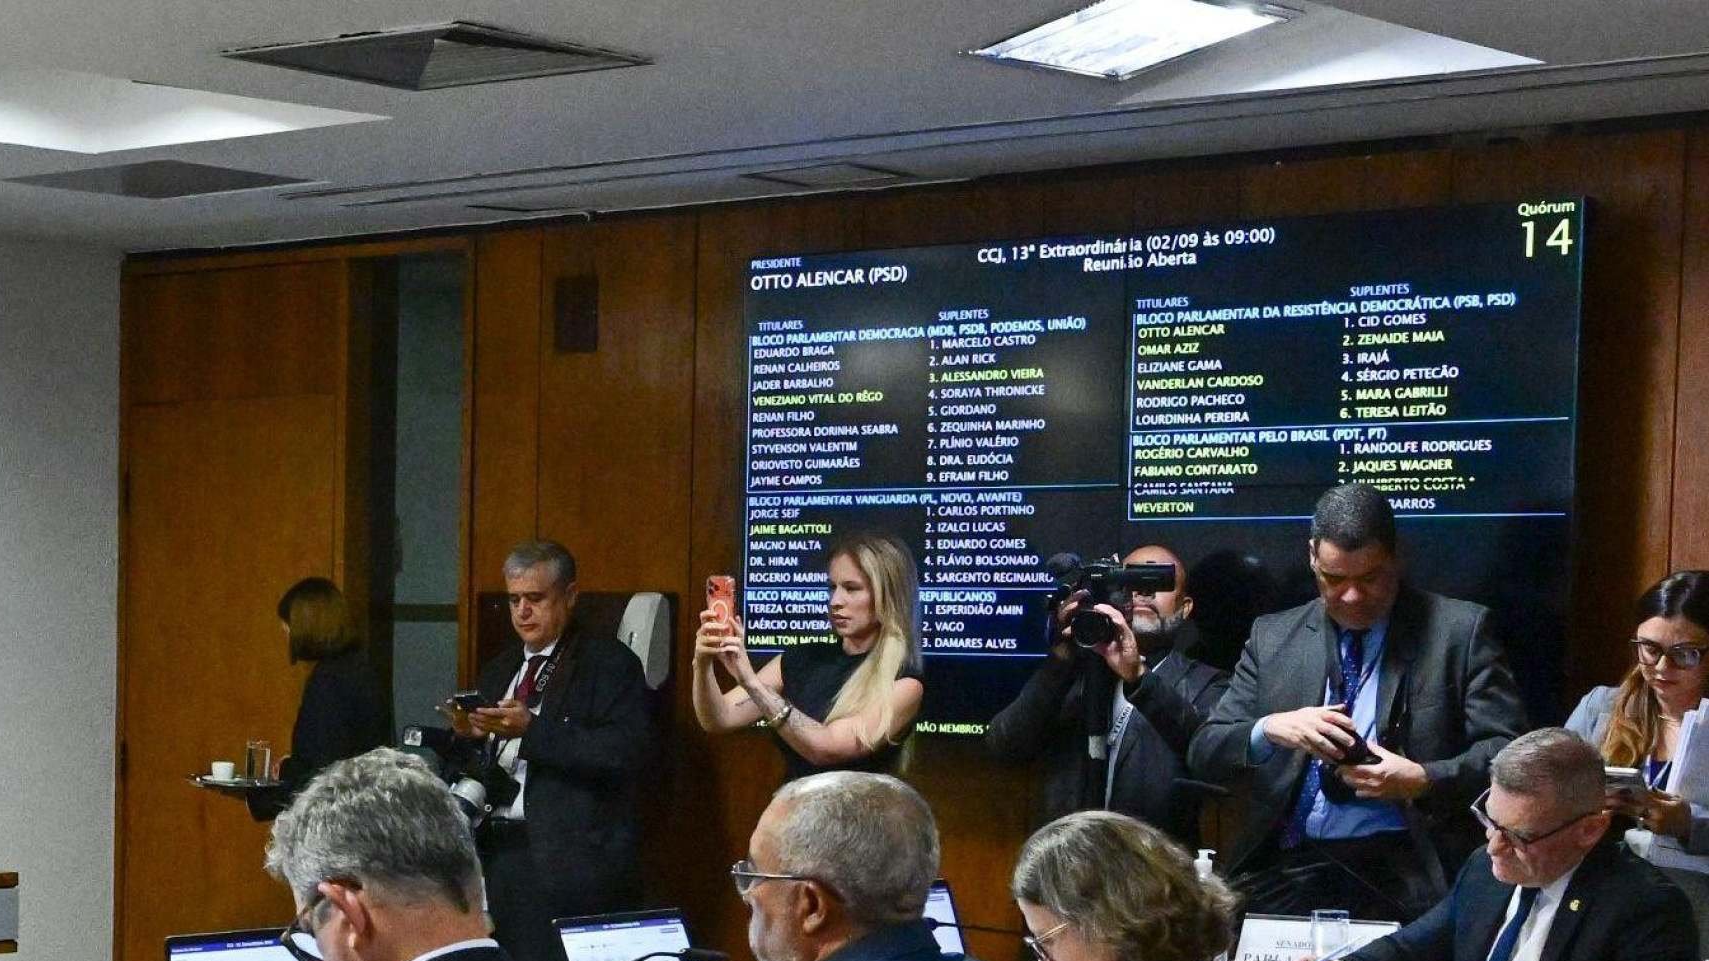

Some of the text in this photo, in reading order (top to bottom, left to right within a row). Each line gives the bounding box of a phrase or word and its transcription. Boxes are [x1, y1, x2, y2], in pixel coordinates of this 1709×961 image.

[1517, 201, 1575, 217] Quórum
[1521, 218, 1573, 257] 14
[977, 227, 1275, 264] CCJ, 13ª Extraordinária (02/09 às 09:00)
[751, 257, 801, 269] PRESIDENTE
[1146, 252, 1197, 267] Aberta
[750, 265, 908, 290] OTTO ALENCAR (PSD)
[1350, 283, 1410, 297] SUPLENTES
[1136, 297, 1189, 309] TITULARES
[1136, 292, 1517, 325] BLOCO PARLAMENTAR DA RESISTÊNCIA DEMOCRÁTICA (PSB, PSD)
[938, 309, 989, 321] SUPLENTES
[1357, 313, 1427, 327] CID GOMES
[751, 317, 1086, 346] BLOCO PARLAMENTAR DEMOCRACIA (MDB, PSDB, PODEMOS, UNIÃO)
[1137, 324, 1225, 339] OTTO ALENCAR
[1357, 330, 1445, 345] ZENAIDE MAIA
[942, 334, 1036, 349] MARCELO CASTRO
[753, 347, 800, 359] EDUARDO
[1137, 342, 1200, 356] OMAR AZIZ
[941, 354, 970, 366] ALAN
[1357, 349, 1390, 365] IRAJÁ
[787, 360, 841, 373] CALHEIROS
[1137, 359, 1223, 373] ELIZIANE GAMA
[940, 368, 1044, 382] ALESSANDRO VIEIRA
[1356, 365, 1460, 382] SÉRGIO PETECÃO
[753, 377, 834, 392] JADER BARBALHO
[1136, 375, 1264, 390] VANDERLAN CARDOSO
[752, 390, 884, 406] VENEZIANO VITAL DO RÊGO
[940, 384, 1045, 399] SORAYA THRONICKE
[1356, 386, 1448, 400] MARA GABRILLI
[1136, 393, 1246, 408] RODRIGO PACHECO
[752, 411, 815, 423] RENAN FILHO
[940, 404, 997, 416] GIORDANO
[1354, 402, 1447, 418] TERESA LEITÃO
[1135, 411, 1250, 425] LOURDINHA PEREIRA
[752, 424, 899, 438] PROFESSORA DORINHA SEABRA
[939, 419, 1046, 433] ZEQUINHA MARINHO
[939, 434, 1020, 449] PLÍNIO VALÉRIO
[1132, 427, 1387, 446] BLOCO PARLAMENTAR PELO BRASIL (PDT, PT)
[751, 441, 858, 454] STYVENSON VALENTIM
[1134, 446, 1250, 460] ROGÉRIO CARVALHO
[1353, 439, 1493, 454] RANDOLFE RODRIGUES
[751, 456, 861, 470] ORIOVISTO GUIMARÃES
[939, 452, 1014, 466] DRA. EUDÓCIA
[1352, 458, 1453, 474] JAQUES WAGNER
[939, 470, 1009, 482] EFRAIM FILHO
[1134, 463, 1258, 476] FABIANO CONTARATO
[750, 475, 823, 488] JAYME CAMPOS
[748, 491, 1022, 507] BLOCO PARLAMENTAR VANGUARDA (PL, NOVO, AVANTE)
[750, 508, 800, 520] JORGE SEIF
[937, 505, 1035, 516] CARLOS PORTINHO
[1133, 502, 1194, 513] WEVERTON
[749, 524, 832, 536] JAIME BAGATTOLI
[937, 522, 1006, 533] IZALCI LUCAS
[750, 540, 822, 551] MAGNO MALTA
[937, 538, 1026, 550] EDUARDO GOMES
[749, 556, 798, 566] DR. HIRAN
[936, 553, 1039, 566] FLÁVIO BOLSONARO
[749, 572, 791, 583] ROGERIO
[936, 572, 991, 583] SARGENTO
[746, 590, 779, 601] BLOCO
[747, 603, 783, 614] TEREZA
[935, 603, 1024, 615] ESPERIDIÃO AMIN
[748, 617, 788, 630] LAÉRCIO
[934, 621, 965, 632] VAGO
[747, 635, 798, 645] HAMILTON
[934, 637, 1017, 649] DAMARES ALVES
[916, 721, 984, 734] NÃO MEMBROS
